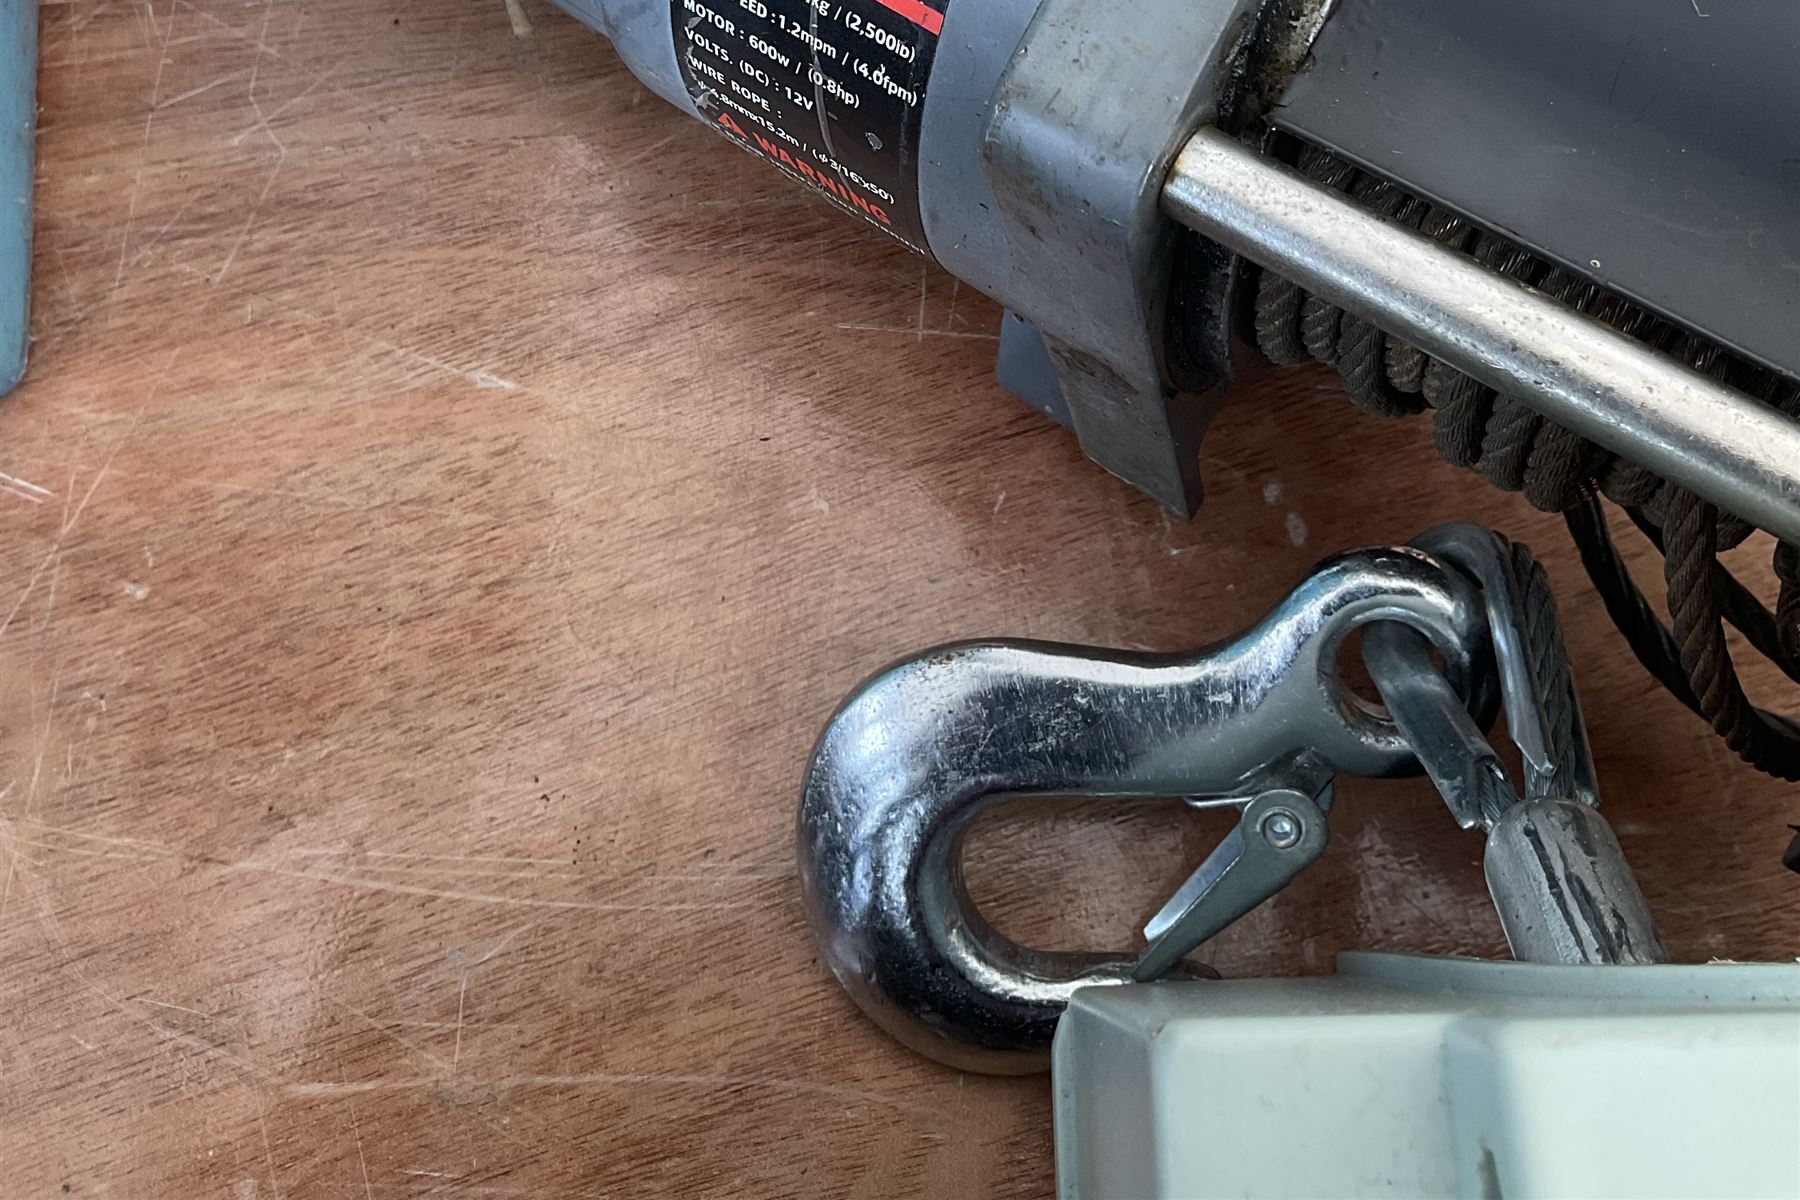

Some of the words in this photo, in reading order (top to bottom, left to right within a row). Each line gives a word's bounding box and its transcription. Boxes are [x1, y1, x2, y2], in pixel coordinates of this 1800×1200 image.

[684, 26, 733, 65] VOLTS.
[739, 60, 770, 87] (DC)
[778, 14, 837, 59] 1.2mpm
[853, 58, 917, 107] (4.0fpm)
[845, 11, 915, 63] (2,500lb)
[690, 55, 726, 85] WIRE
[731, 80, 771, 112] ROPE
[807, 67, 860, 109] (0.8hp)
[752, 131, 891, 225] WARNING
